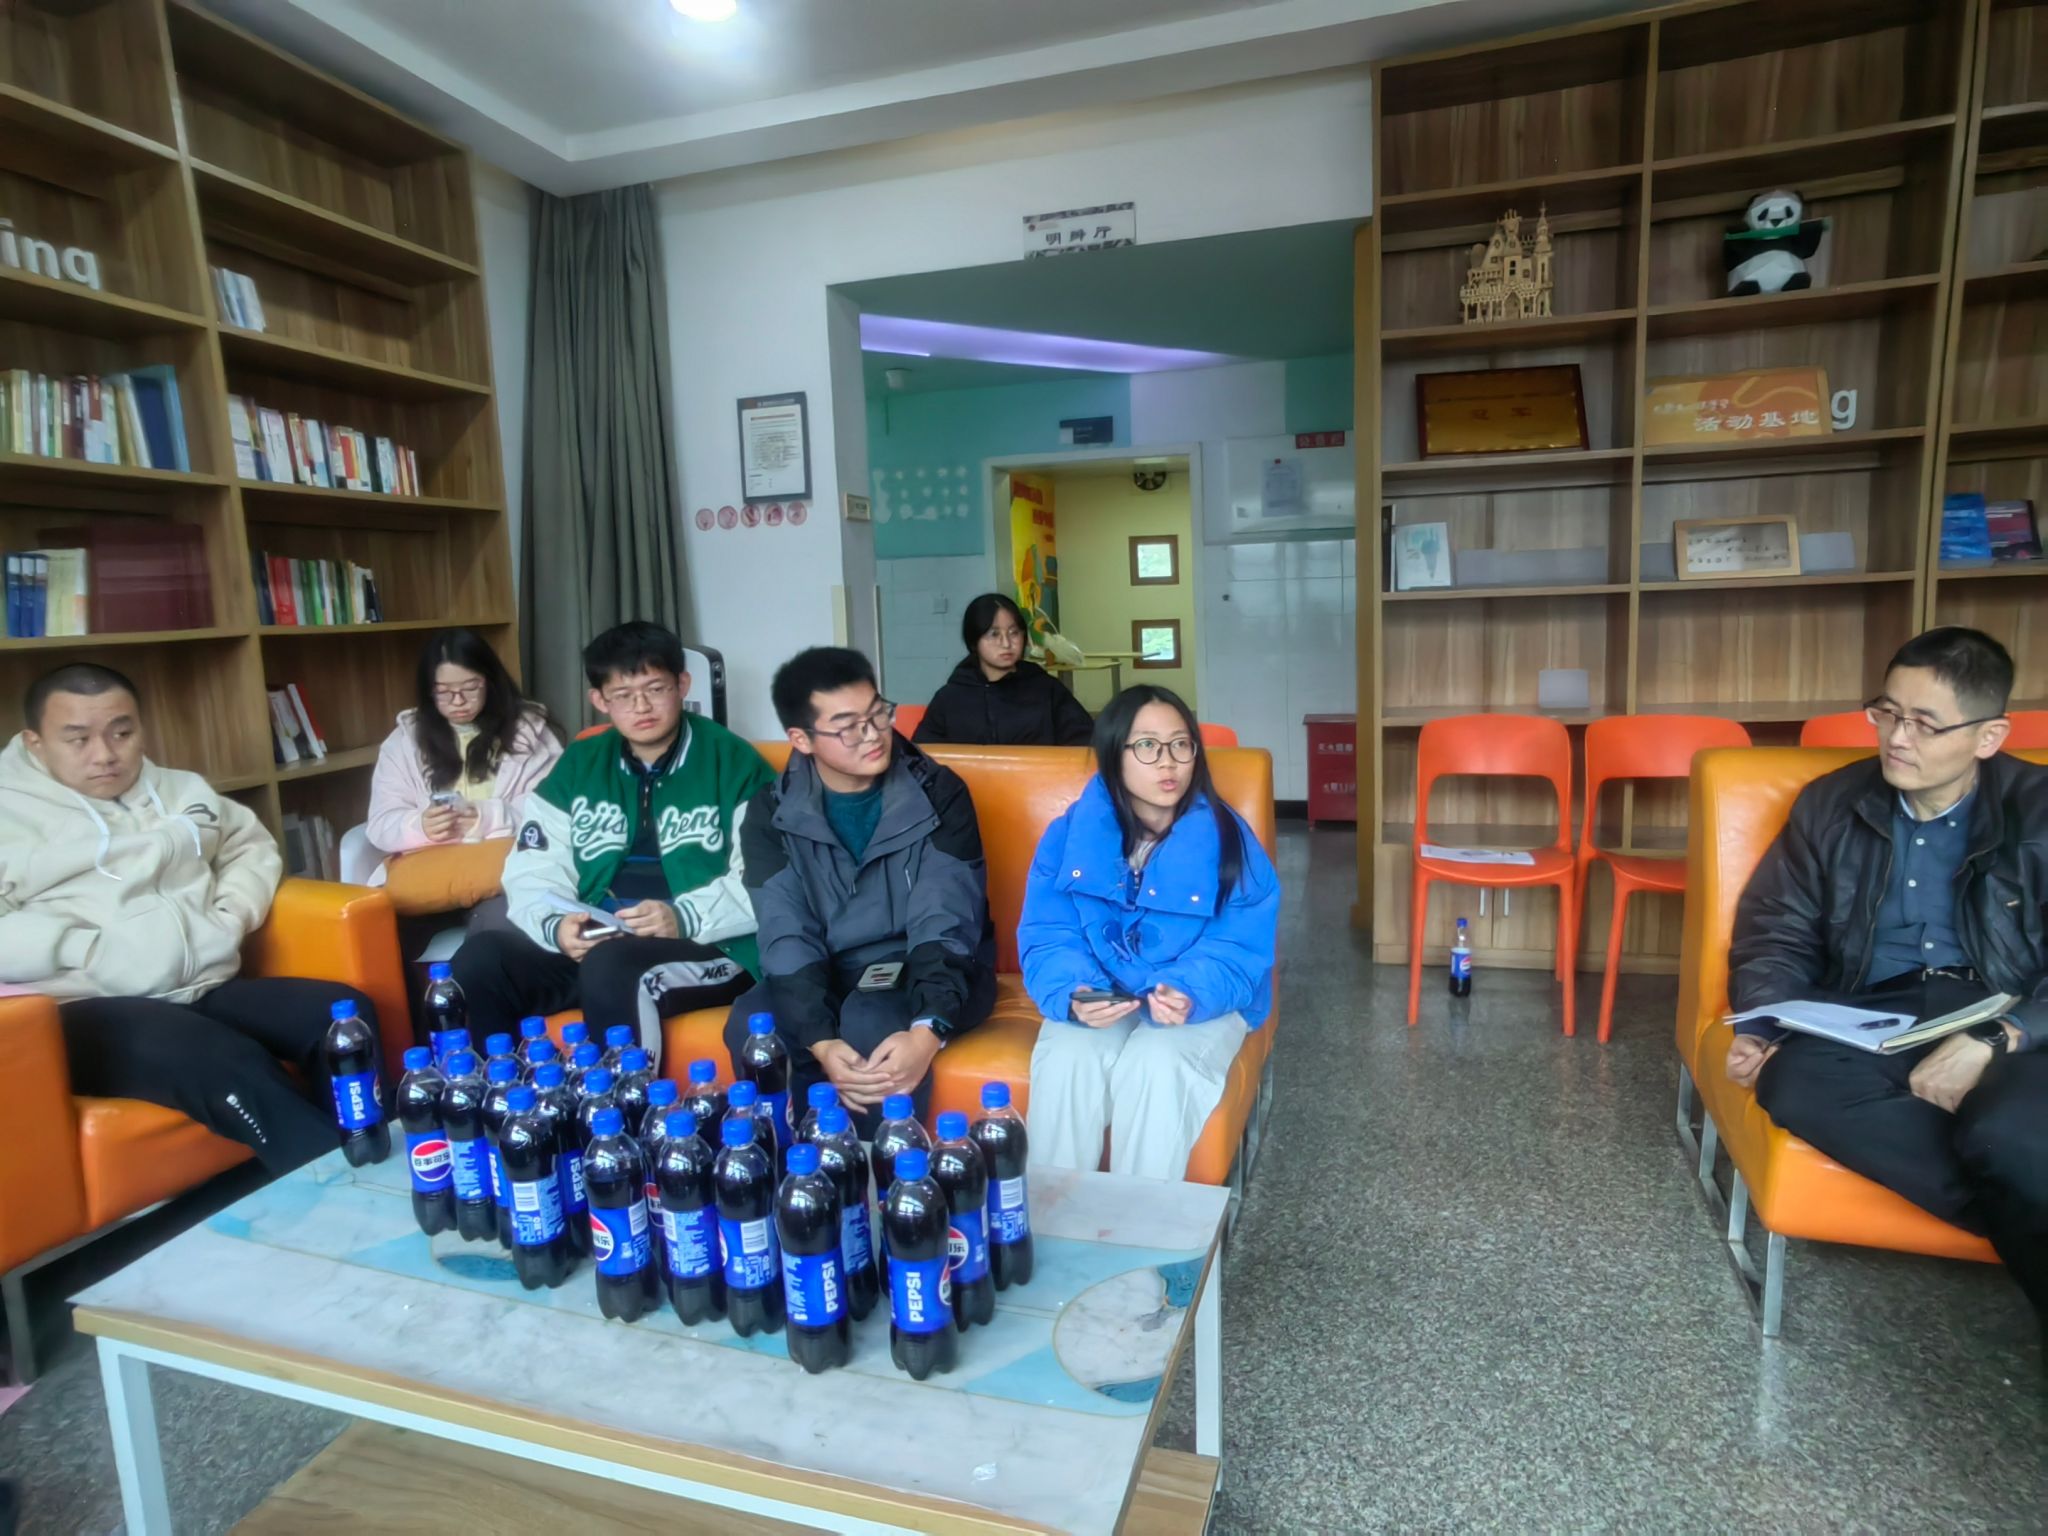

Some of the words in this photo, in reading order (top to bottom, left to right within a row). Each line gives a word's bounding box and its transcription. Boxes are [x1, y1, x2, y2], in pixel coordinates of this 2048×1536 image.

[1694, 409, 1820, 433] 活动基地
[349, 1080, 366, 1121] PEPSI
[569, 1156, 585, 1202] PEPSI
[821, 1260, 839, 1314] PEPSI
[906, 1271, 925, 1323] PEPSI
